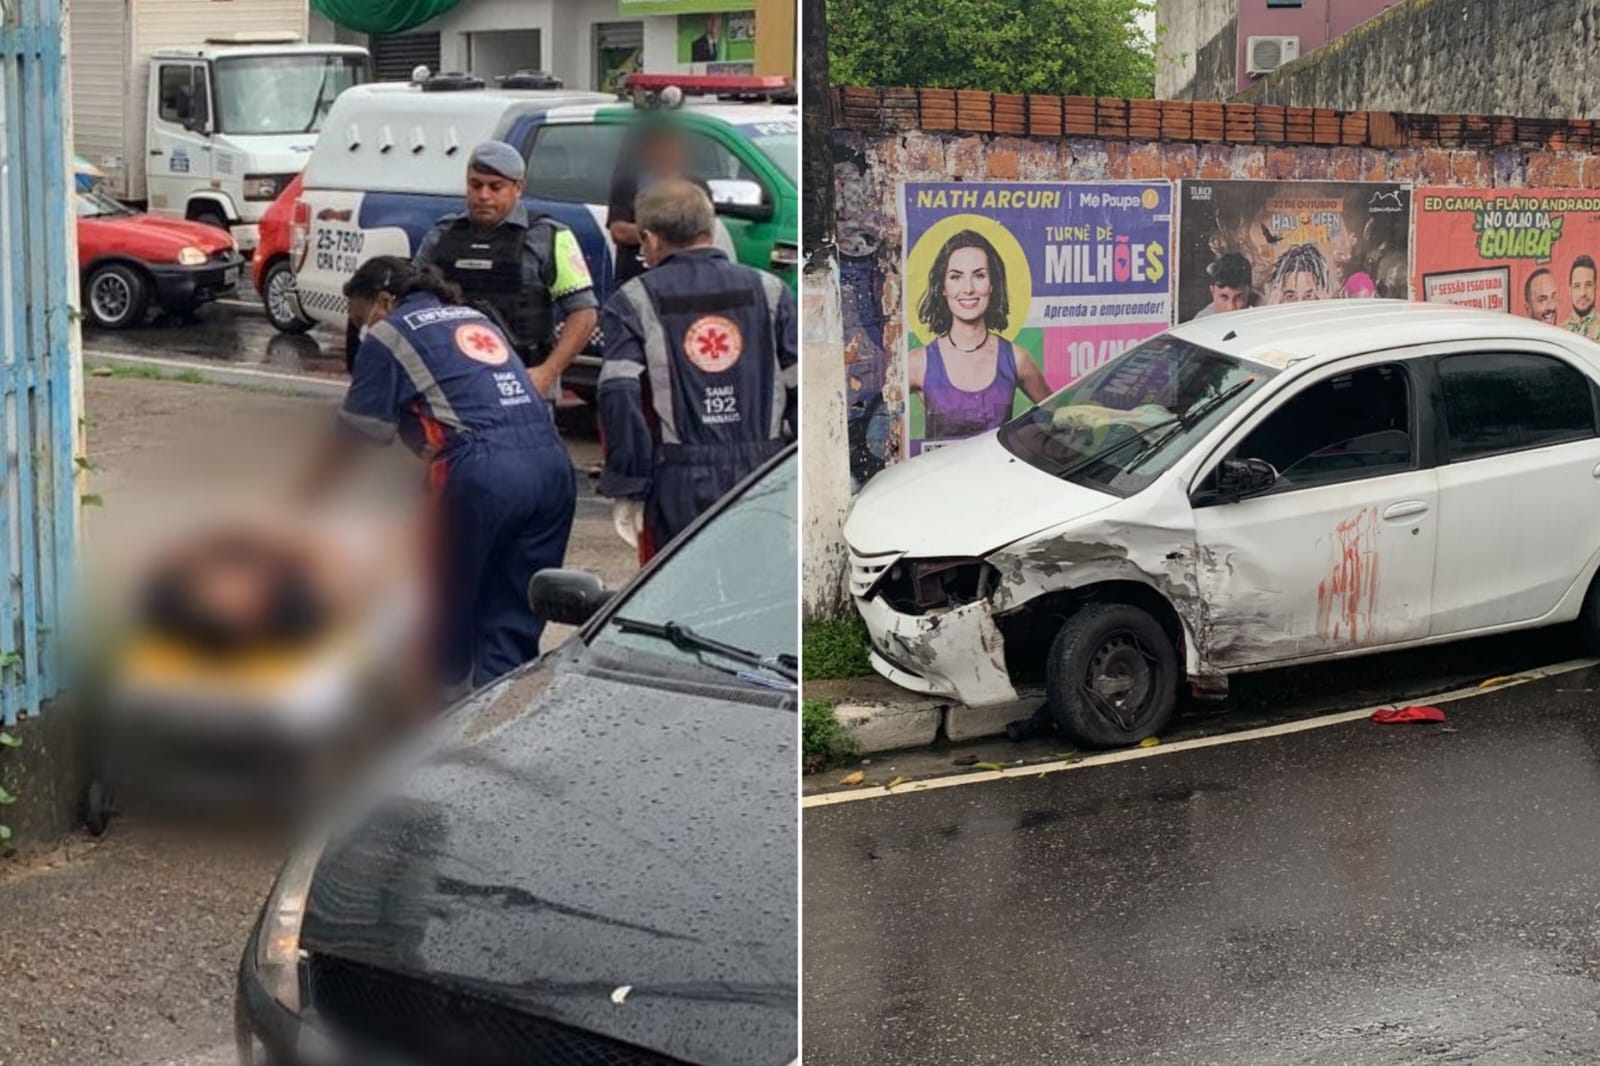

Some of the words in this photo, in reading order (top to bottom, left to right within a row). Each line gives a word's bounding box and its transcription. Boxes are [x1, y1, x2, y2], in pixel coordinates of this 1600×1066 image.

[916, 190, 978, 209] NATH
[981, 190, 1061, 209] ARCURI
[1079, 193, 1100, 208] Me
[1102, 193, 1141, 211] Poupe
[1424, 197, 1443, 211] ED
[1445, 197, 1484, 211] GAMA
[1496, 195, 1539, 211] FLÁVIO
[1483, 211, 1501, 228] NO
[1535, 211, 1551, 228] DA
[316, 228, 366, 254] 25-7500
[1045, 223, 1091, 242] TURNÊ
[1096, 225, 1113, 241] DE
[1479, 227, 1551, 258] GOIABA
[1438, 279, 1466, 295] SESSÃO
[1044, 303, 1088, 319] Aprenda
[1090, 306, 1097, 317] a
[1100, 301, 1165, 318] empreender!
[702, 396, 737, 413] 192
